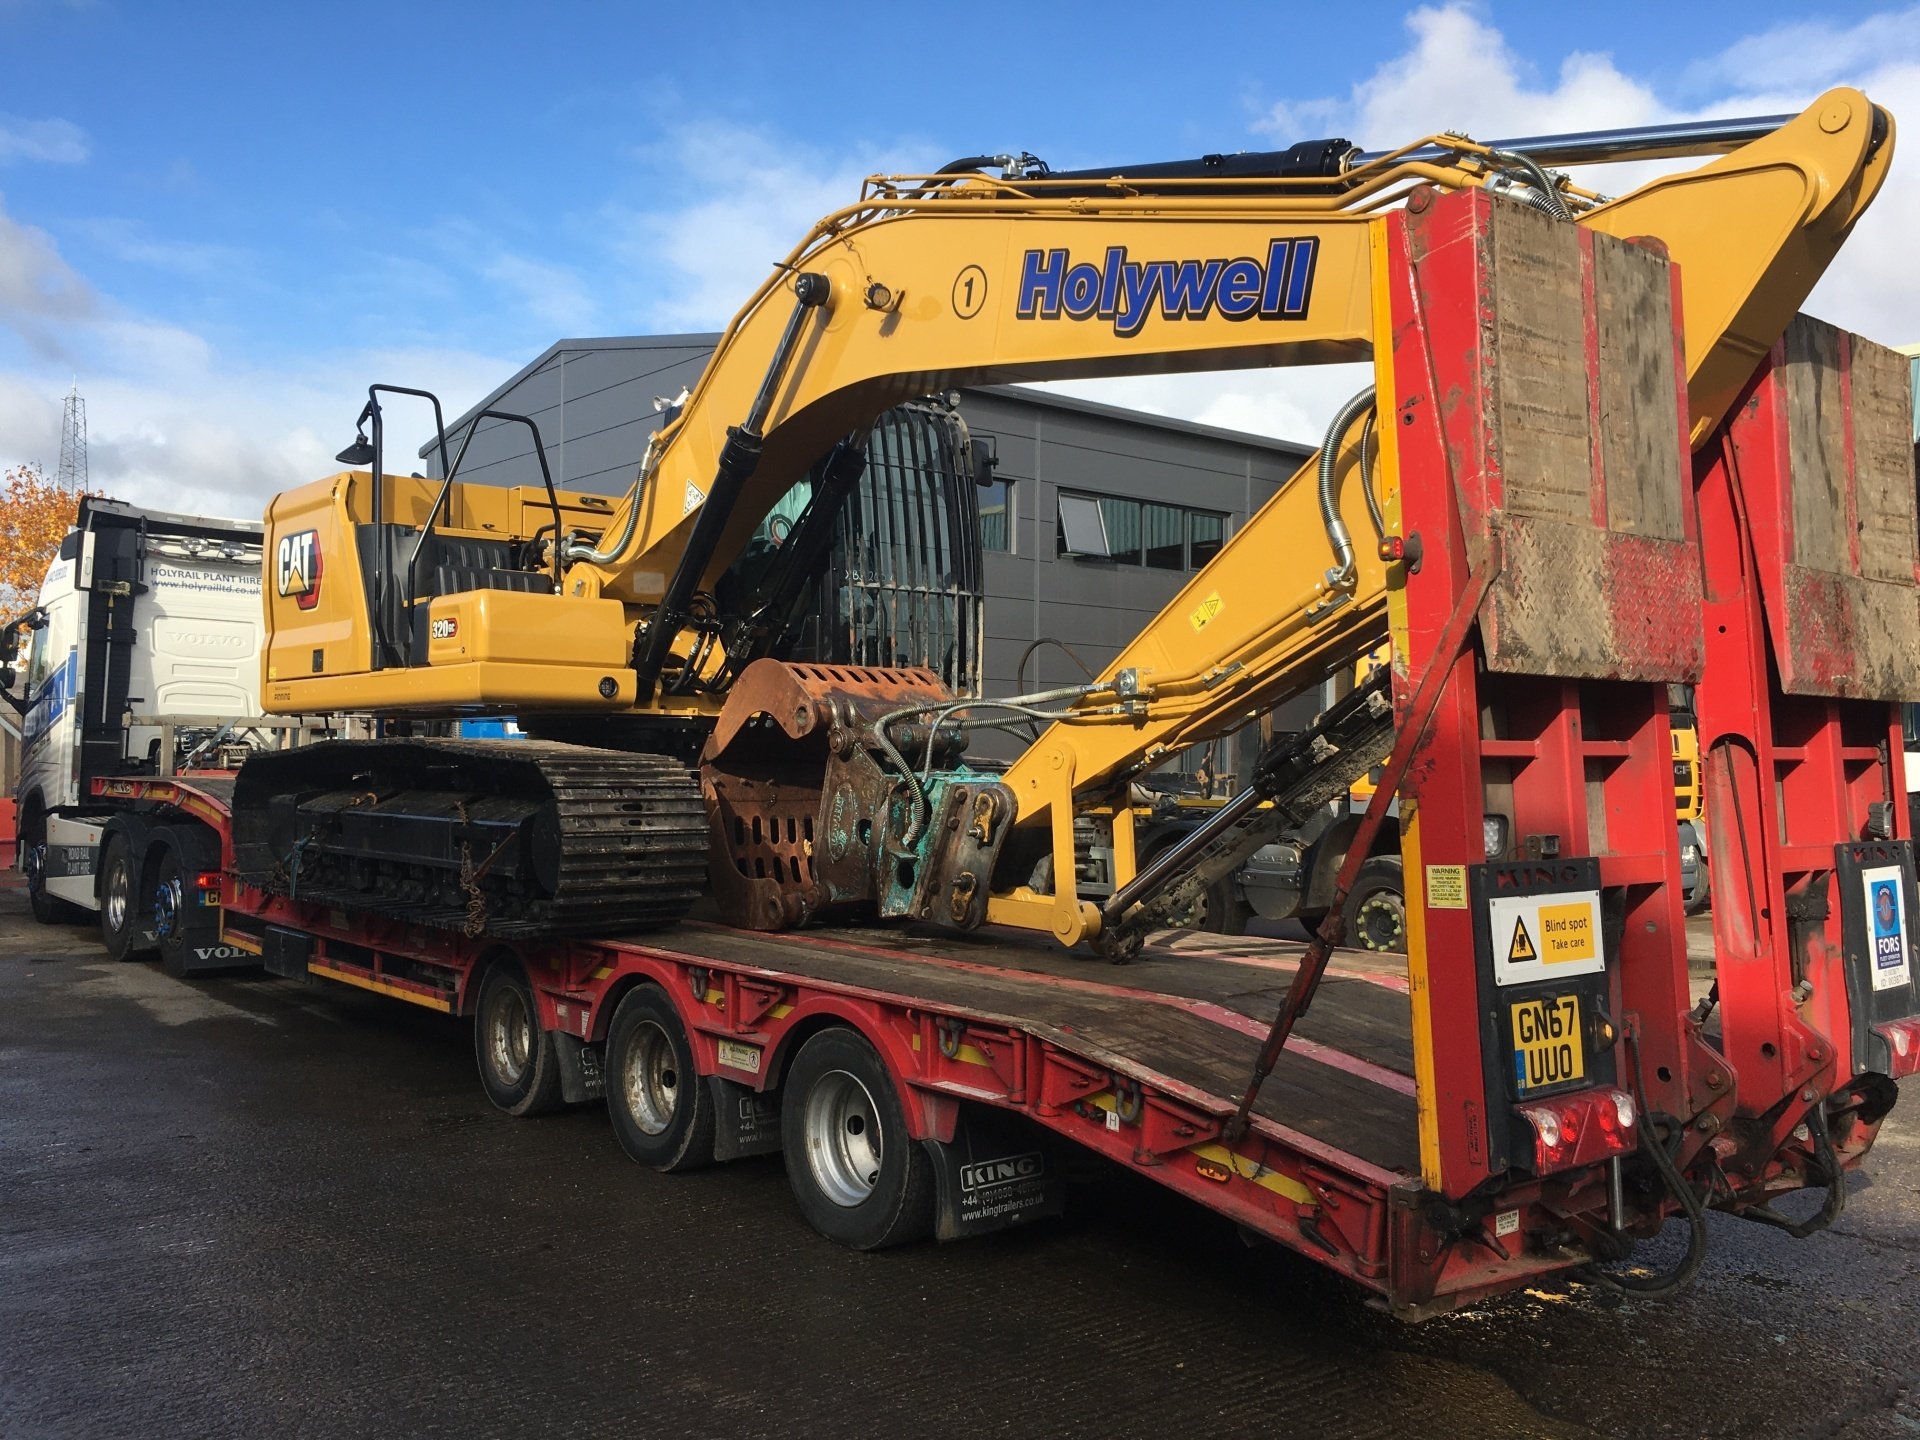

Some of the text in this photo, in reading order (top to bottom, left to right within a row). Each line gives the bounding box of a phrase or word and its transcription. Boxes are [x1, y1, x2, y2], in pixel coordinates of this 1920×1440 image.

[1016, 235, 1321, 339] Holywell
[279, 532, 313, 595] CAT
[151, 567, 262, 586] HOLYRAIL PLANT HIRE
[151, 579, 262, 595] www.holyrailltd.co.uk
[432, 619, 449, 639] 320
[166, 631, 247, 647] VOLVO
[1545, 917, 1587, 932] Blind spot
[194, 946, 257, 960] VOL
[1551, 938, 1585, 950] Take care
[1878, 936, 1900, 955] FORS
[1519, 1001, 1575, 1043] GN67
[1529, 1044, 1573, 1085] UUO
[1109, 1112, 1117, 1127] H
[966, 1158, 1036, 1186] KING
[961, 1193, 1045, 1222] www.kingtrailers.co.uk
[962, 1195, 978, 1206] +44
